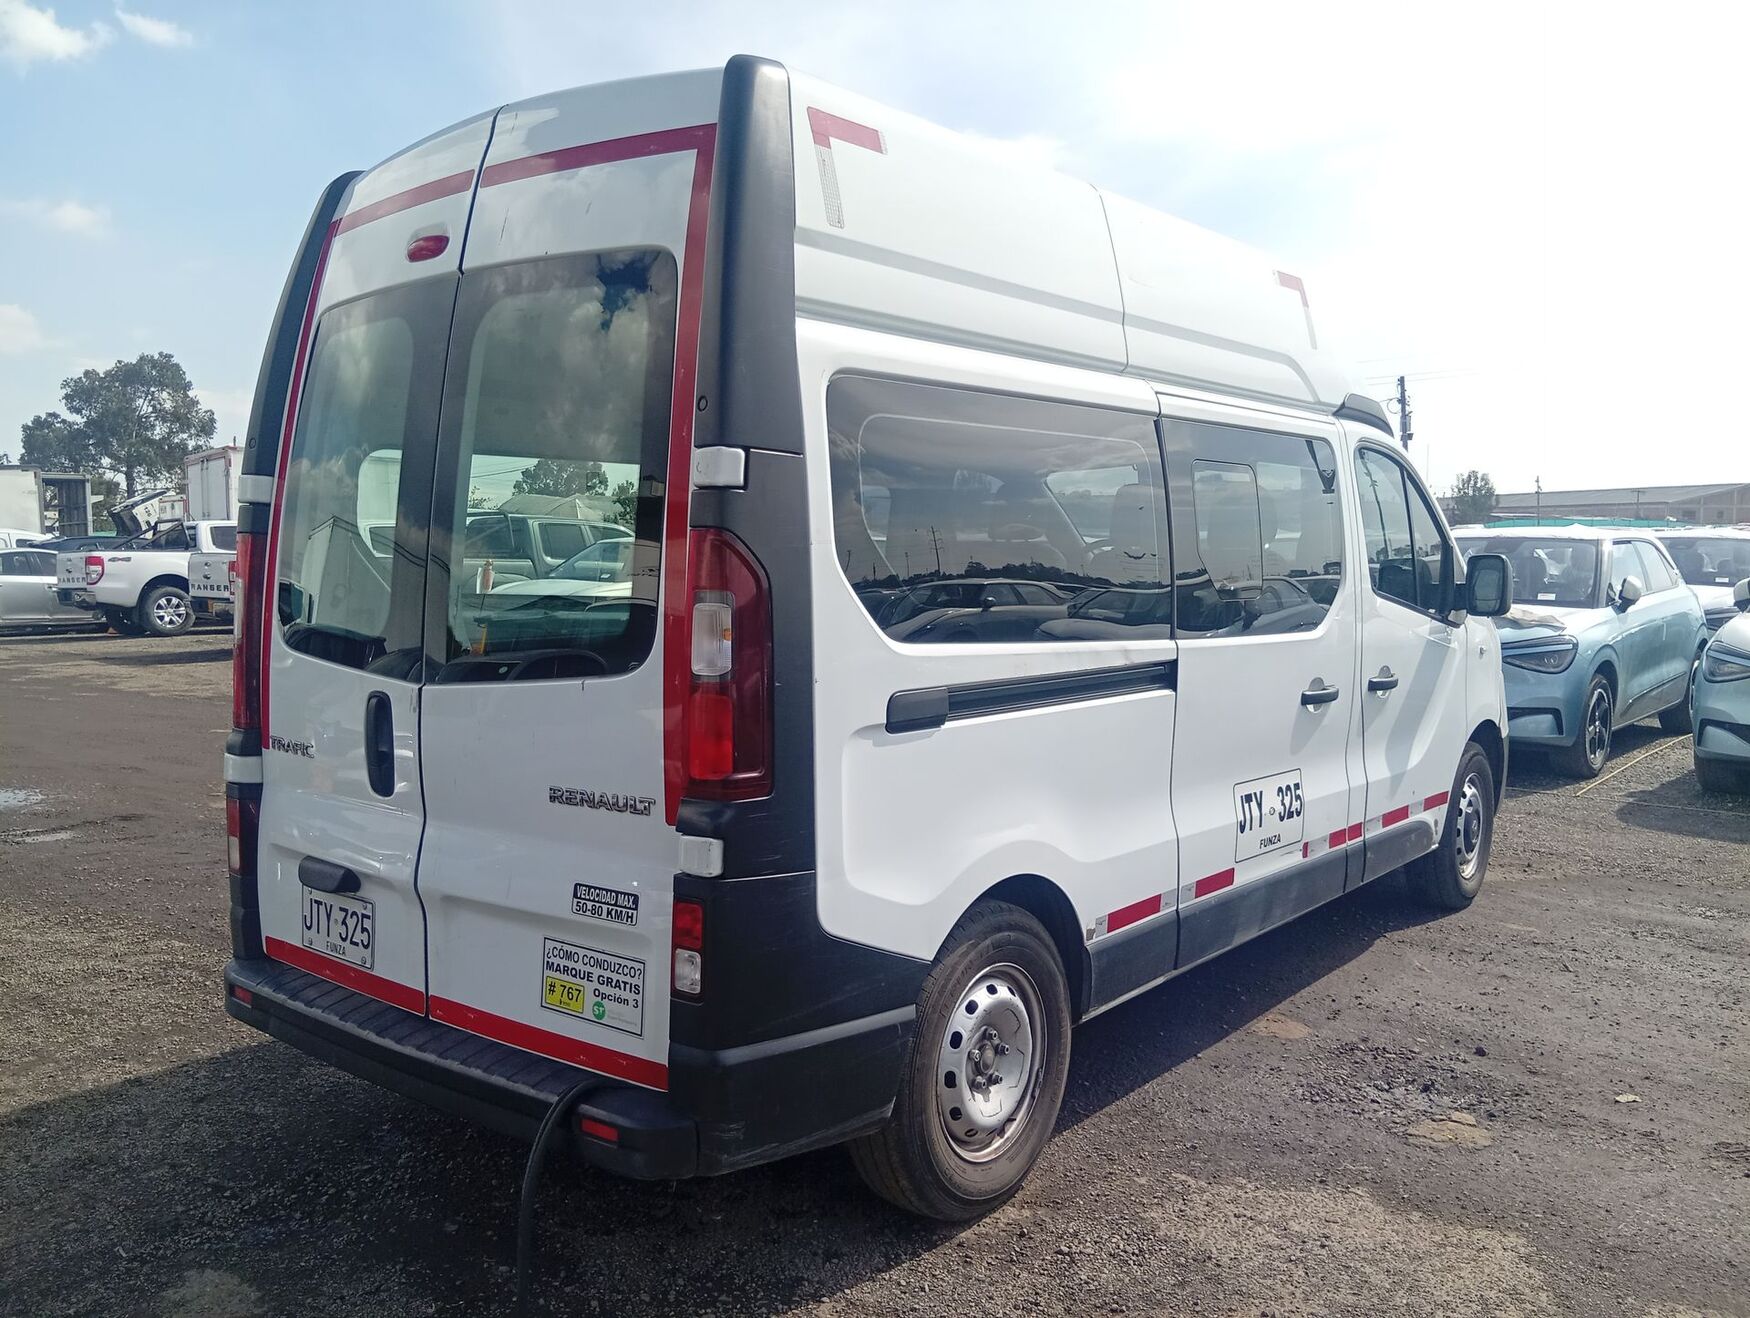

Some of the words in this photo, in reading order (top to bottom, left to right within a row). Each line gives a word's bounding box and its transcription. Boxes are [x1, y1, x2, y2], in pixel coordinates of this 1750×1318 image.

[270, 735, 315, 759] TRAFIC
[548, 785, 656, 816] RENAULT
[1239, 790, 1263, 834] JTY
[1277, 782, 1303, 822] 325
[1259, 834, 1281, 849] FUNZA
[577, 885, 616, 903] VELOCIDAD
[617, 894, 636, 908] MAX.
[304, 898, 333, 937] JTY
[338, 906, 371, 950] 325
[575, 901, 603, 916] 50-80
[606, 908, 634, 924] KM/H
[326, 940, 346, 956] FUNZA
[546, 945, 580, 964] ¿CÓMO
[582, 954, 642, 980] CONDUZCO?
[546, 961, 594, 983] MARQUE
[597, 974, 641, 995] GRATIS
[560, 984, 582, 1002] 767
[593, 988, 629, 1006] Opción
[632, 998, 639, 1008] 3
